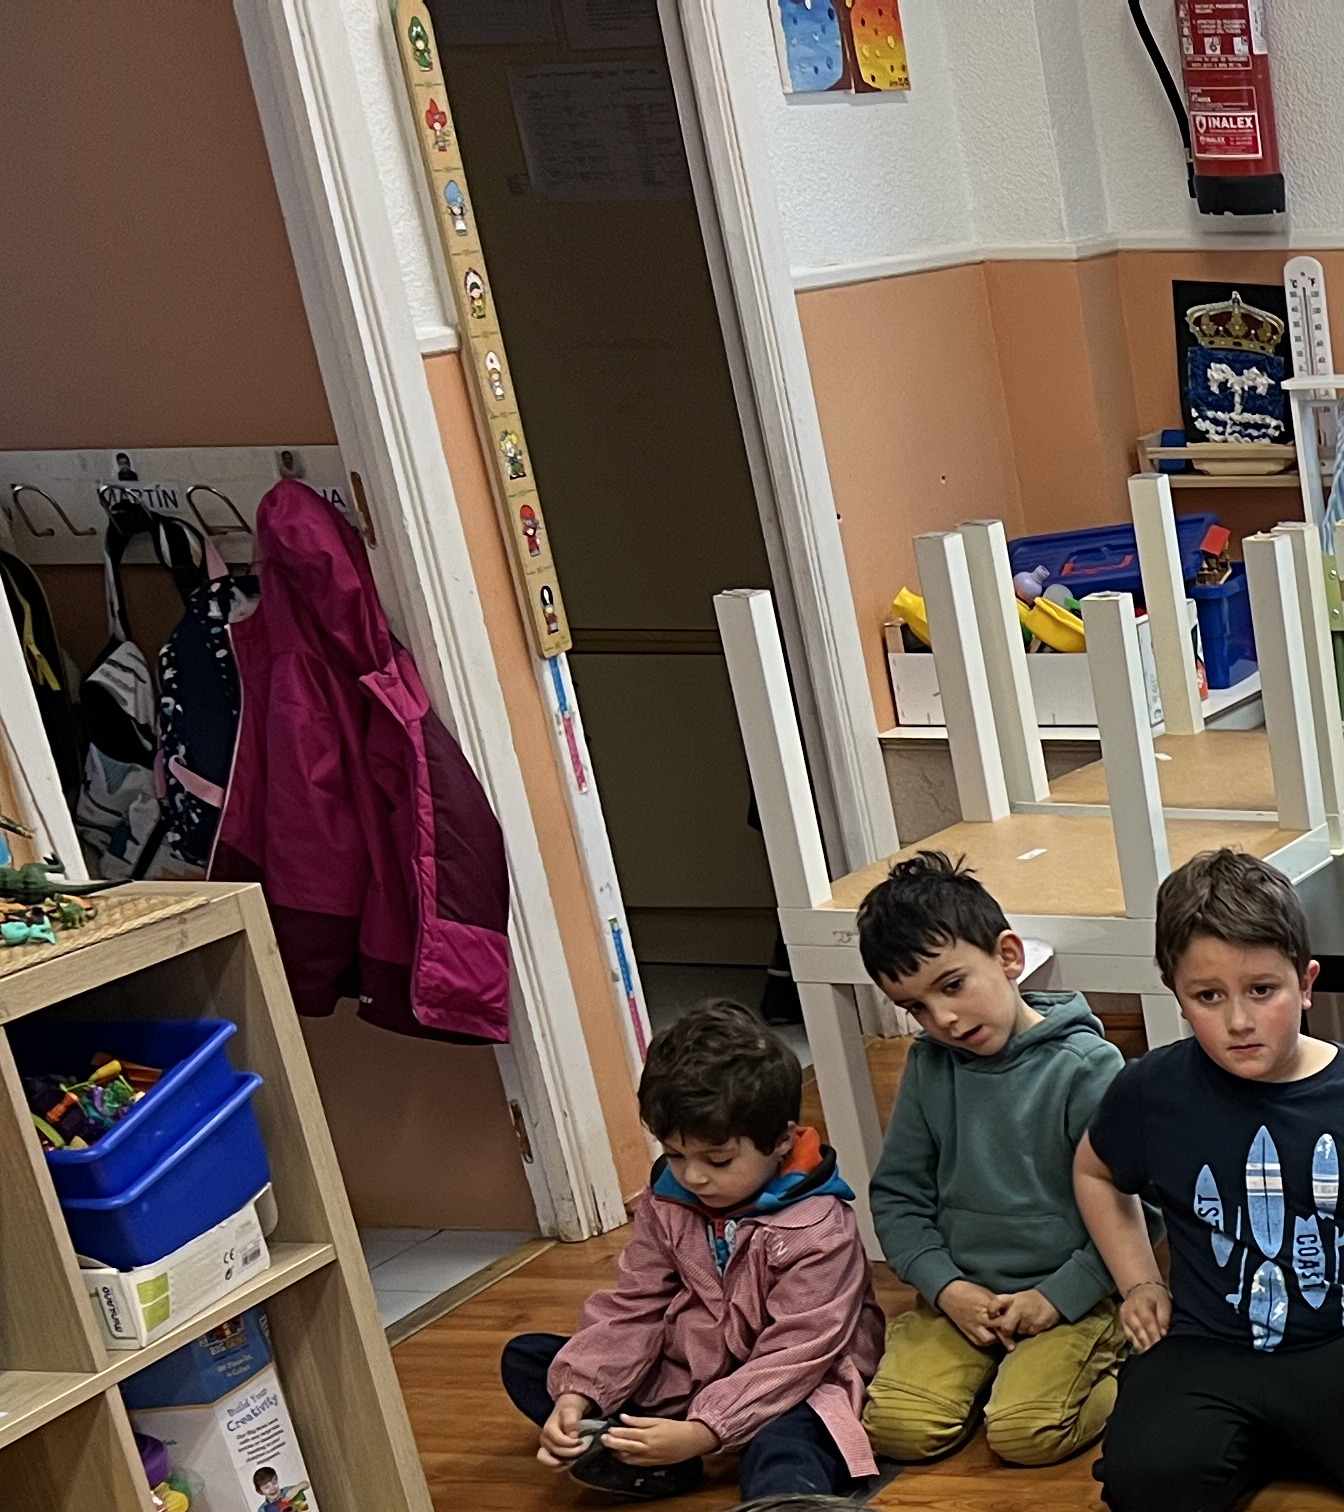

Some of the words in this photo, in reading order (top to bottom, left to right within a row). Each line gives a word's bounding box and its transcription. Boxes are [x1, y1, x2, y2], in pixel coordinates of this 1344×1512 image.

[1208, 116, 1253, 128] INALEX
[1297, 1233, 1326, 1290] COAST
[226, 1393, 279, 1432] Creativity
